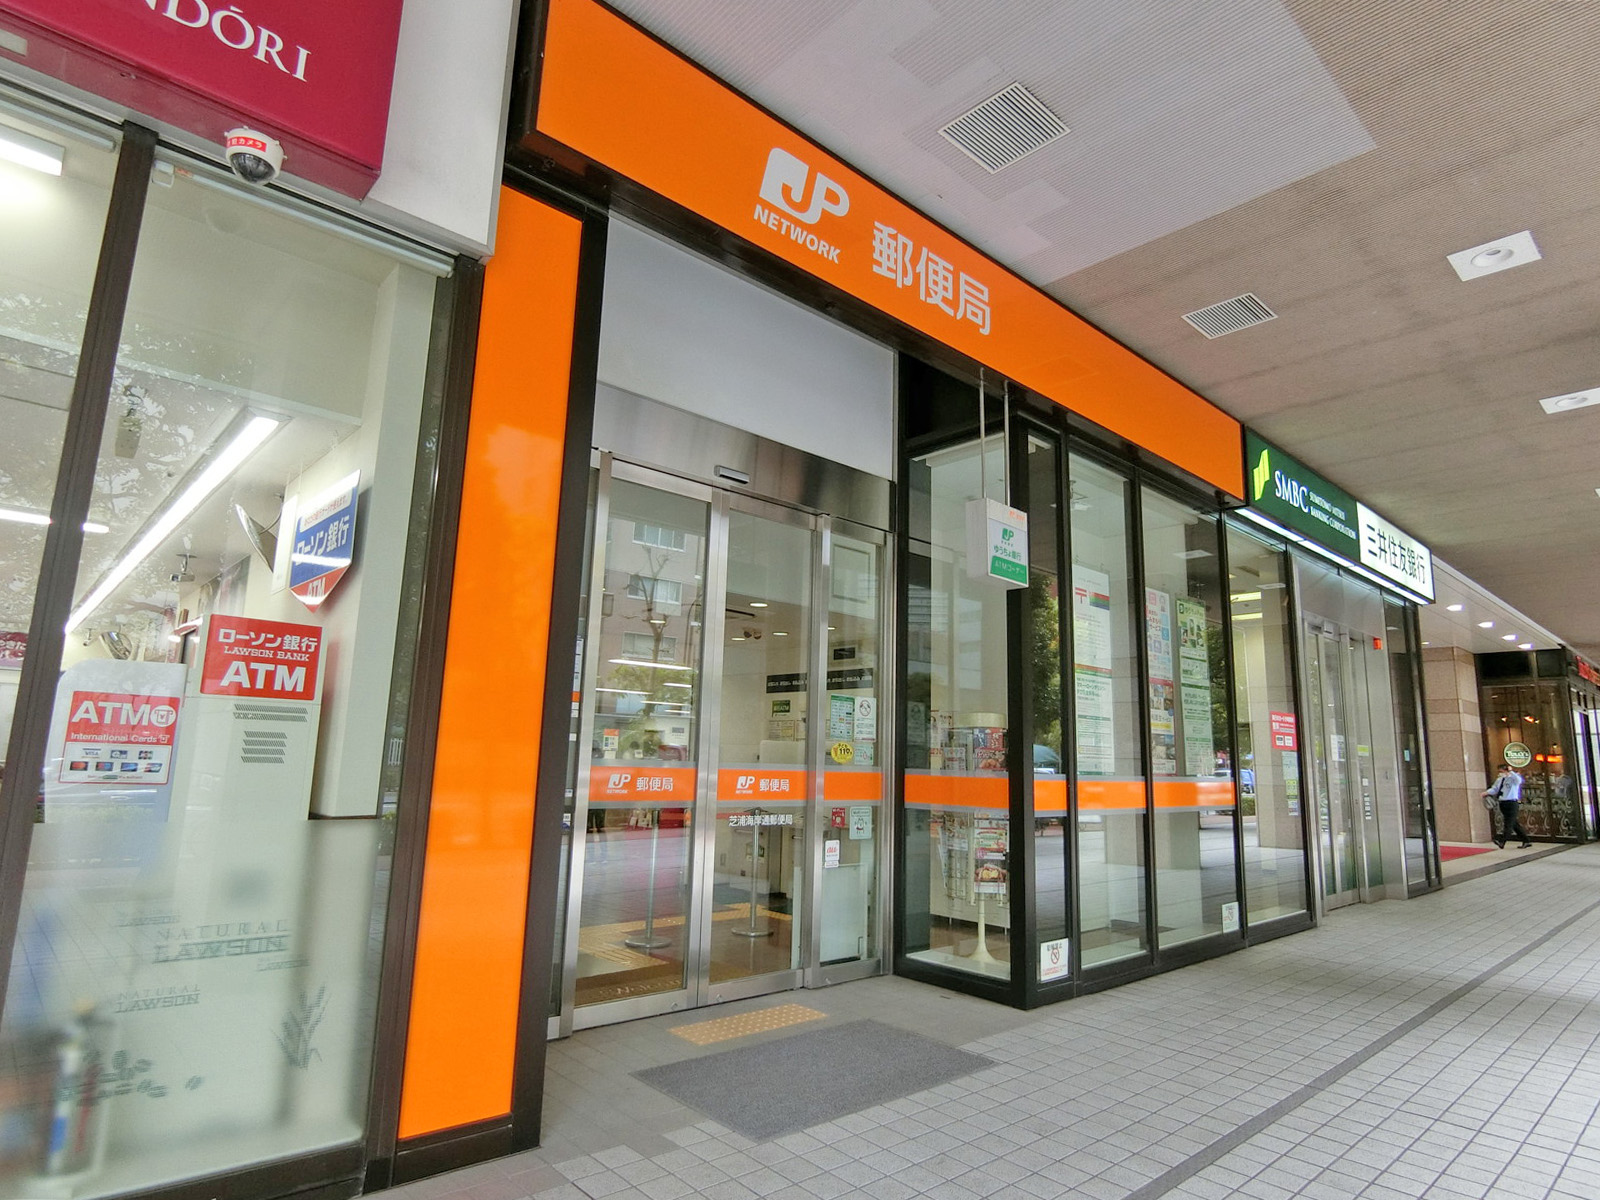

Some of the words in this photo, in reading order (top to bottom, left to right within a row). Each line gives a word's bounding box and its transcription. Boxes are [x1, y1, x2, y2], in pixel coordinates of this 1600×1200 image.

[144, 0, 312, 82] DÓRI
[758, 147, 850, 225] JP
[753, 204, 841, 264] NETWORK
[872, 220, 991, 335] 郵便局
[1274, 470, 1309, 513] SMBC
[296, 514, 350, 566] ローソン銀行
[1366, 523, 1426, 584] 三井住友銀行
[307, 576, 326, 597] ATM
[218, 628, 318, 653] ローソン銀行
[224, 645, 274, 659] LAWSON
[276, 651, 310, 662] BANK
[220, 660, 307, 692] ATM
[71, 700, 152, 726] ATM
[70, 732, 128, 742] International
[130, 734, 157, 743] Cards
[607, 773, 632, 789] JP
[635, 776, 674, 792] 郵便局
[736, 775, 756, 789] JP
[759, 778, 790, 792] 郵便局
[728, 813, 793, 827] 芝浦海岸通郵便局
[114, 993, 201, 1013] LAWSON
